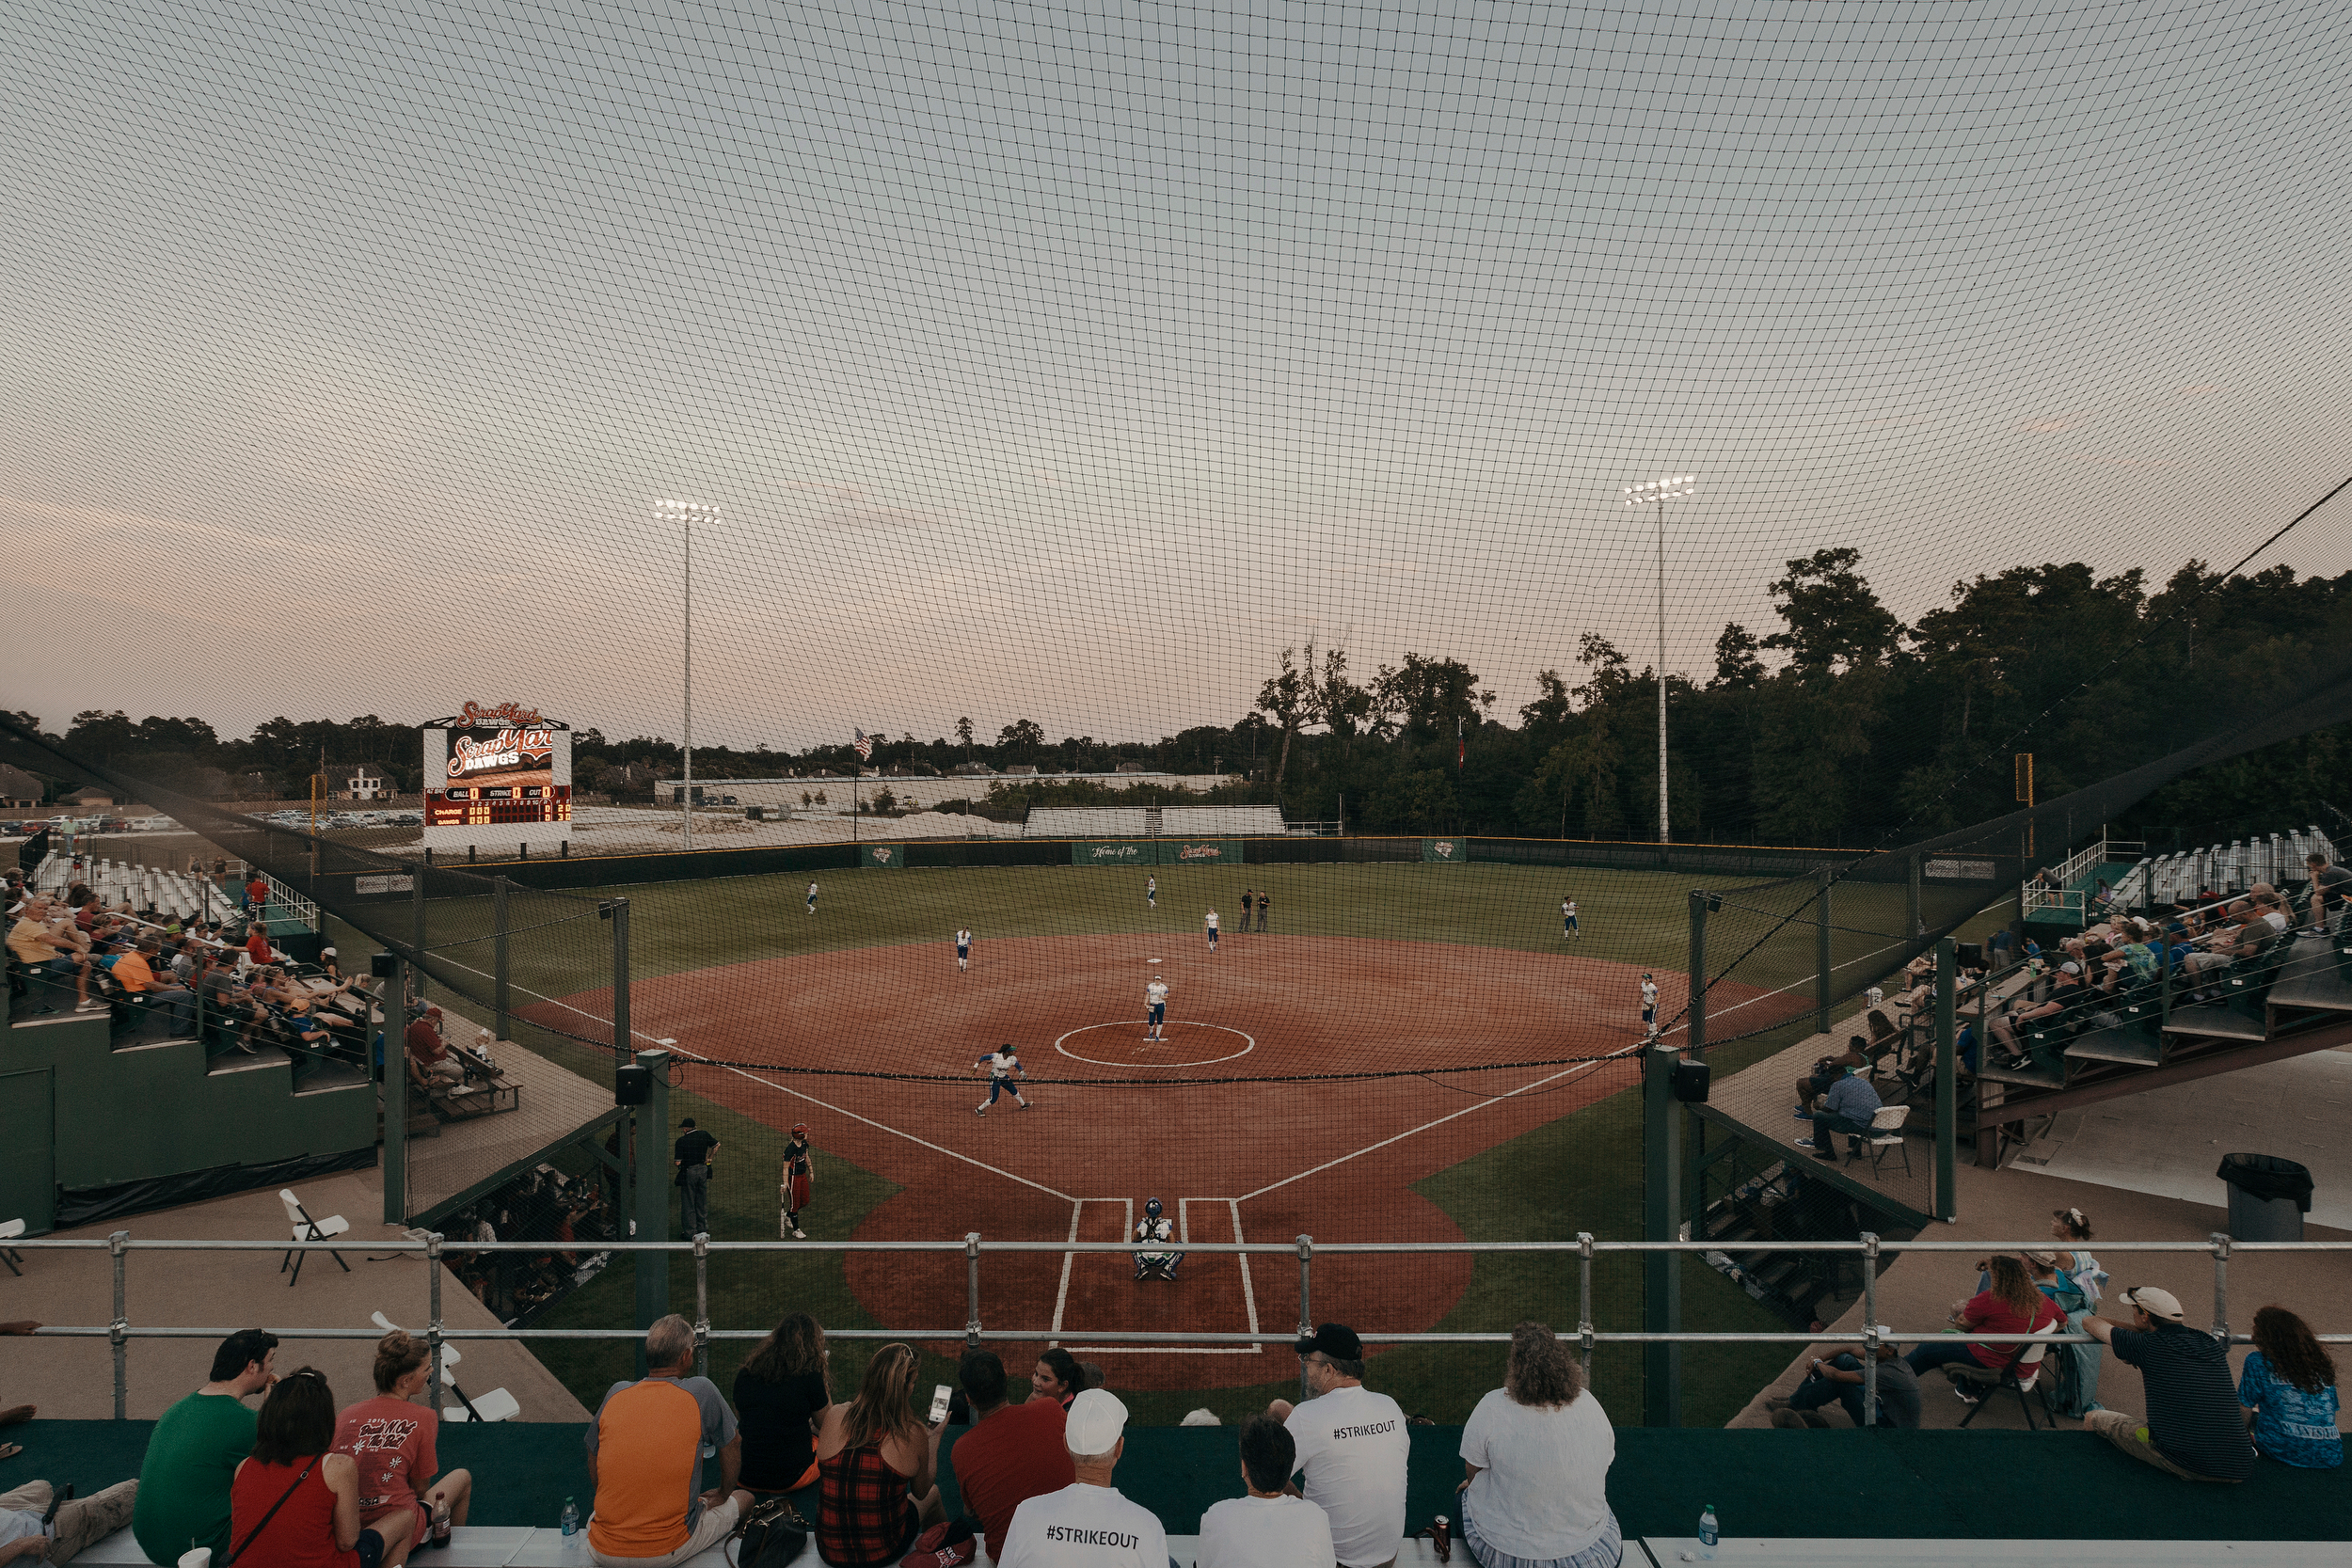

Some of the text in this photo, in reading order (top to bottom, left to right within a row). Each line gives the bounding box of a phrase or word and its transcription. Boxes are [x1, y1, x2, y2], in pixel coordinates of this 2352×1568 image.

[465, 752, 519, 770] DAWGS
[1092, 846, 1117, 858] Home
[1117, 846, 1125, 858] of
[1333, 1419, 1396, 1440] #STRIKEOUT
[1046, 1525, 1139, 1550] #STRIKEOUT
